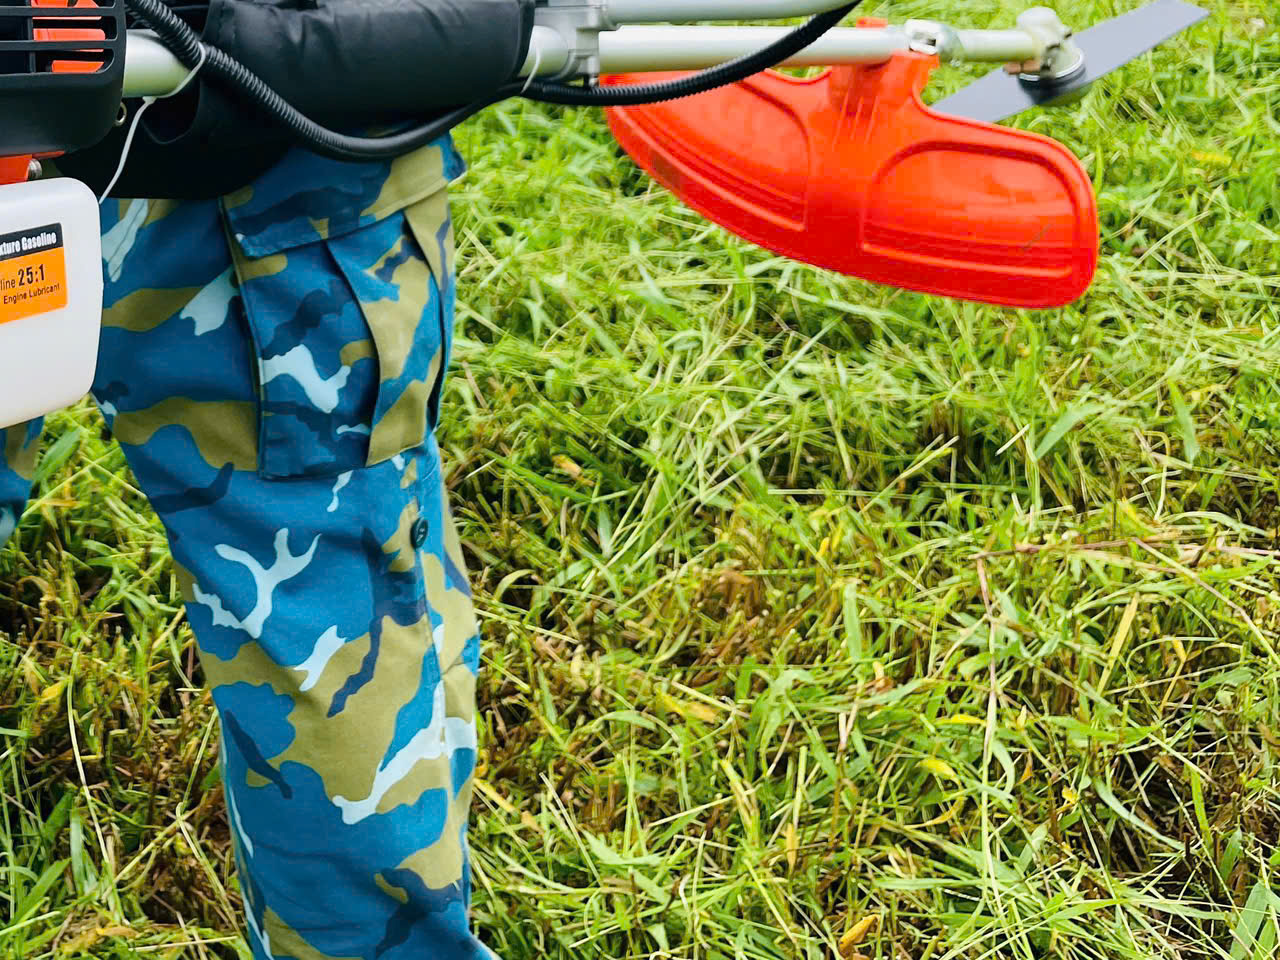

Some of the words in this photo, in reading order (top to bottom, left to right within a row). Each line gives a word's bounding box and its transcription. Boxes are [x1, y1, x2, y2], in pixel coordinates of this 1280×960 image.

[21, 231, 57, 251] Gasoline
[17, 263, 45, 287] 25:1
[3, 291, 27, 305] Engine
[28, 283, 61, 299] Lubricant
